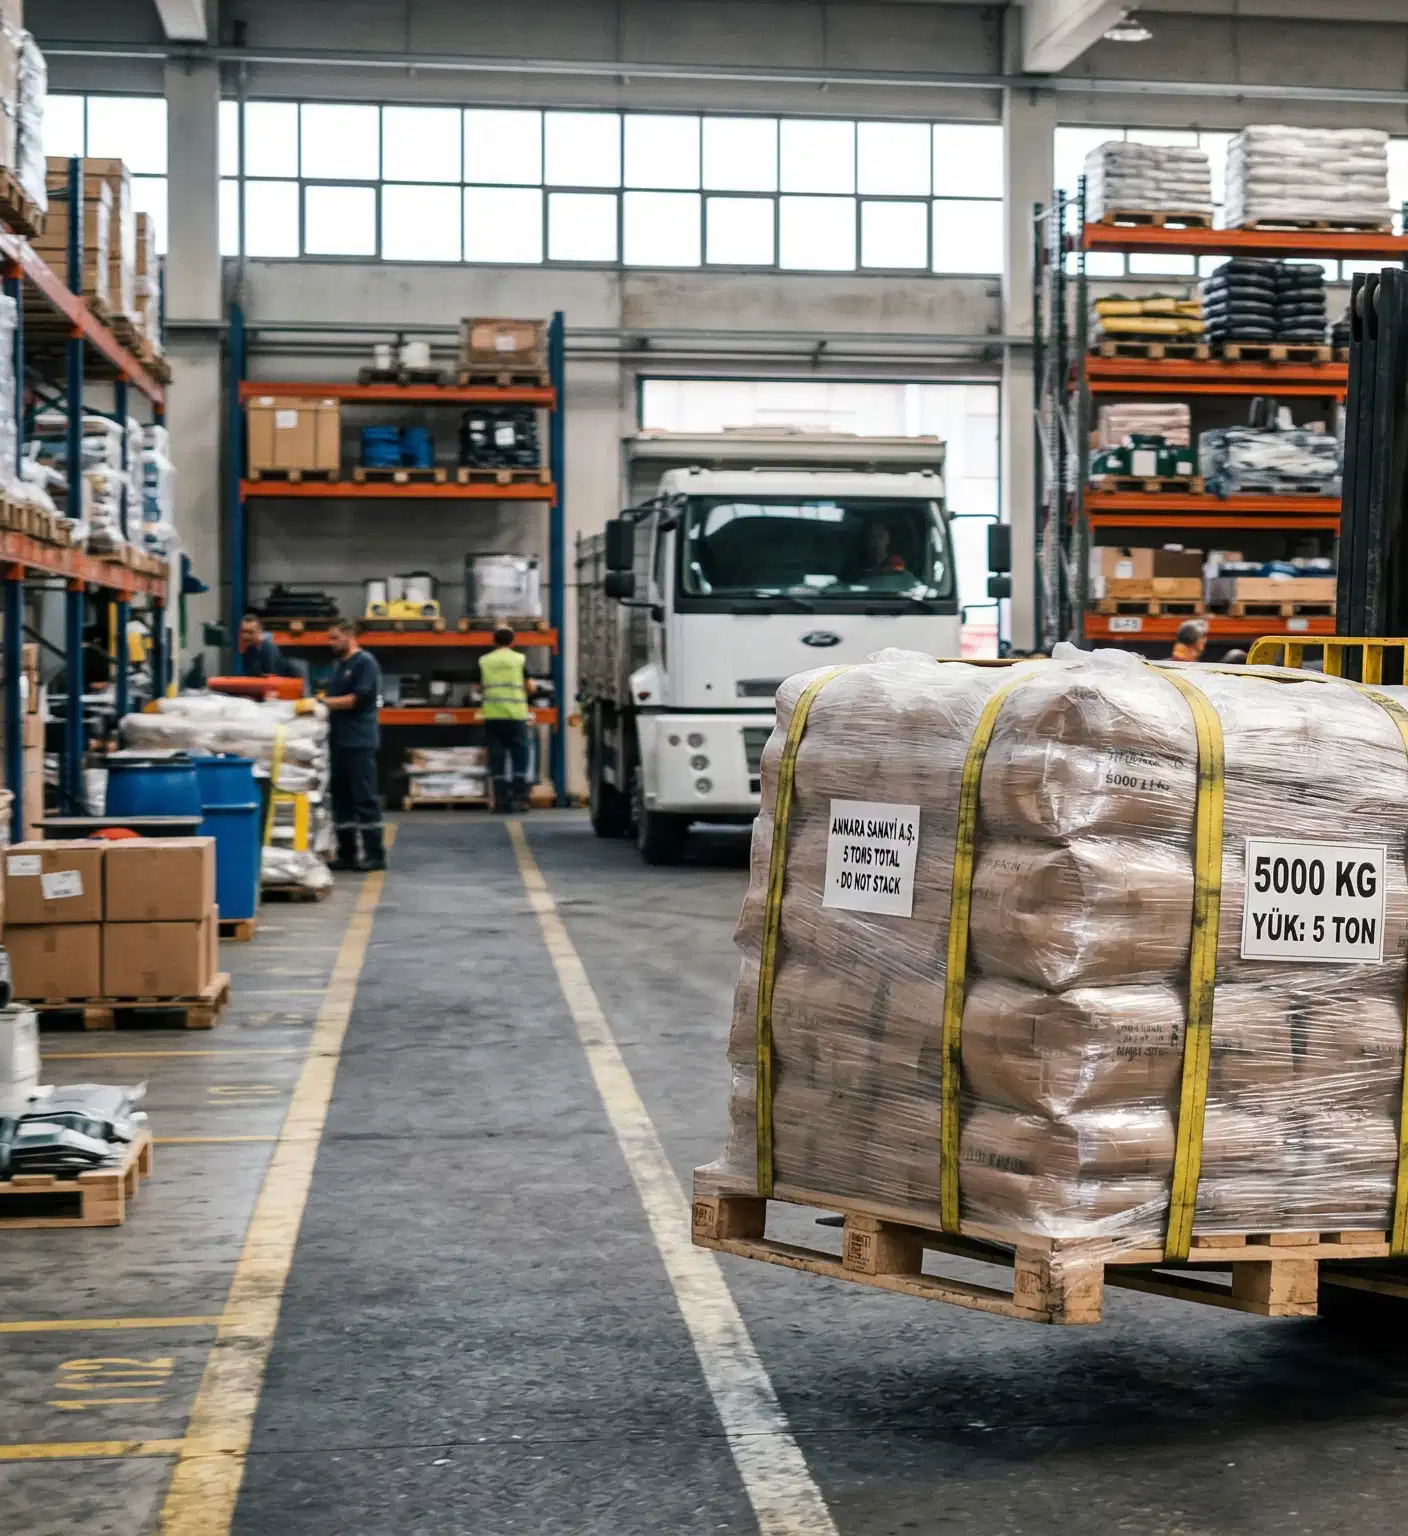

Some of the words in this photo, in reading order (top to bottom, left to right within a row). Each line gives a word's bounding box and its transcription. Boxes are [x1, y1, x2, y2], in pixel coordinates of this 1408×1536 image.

[843, 845, 849, 863] 5
[874, 848, 900, 868] TOTAL
[840, 871, 853, 890] DO
[854, 872, 872, 892] NOT
[873, 875, 902, 895] STACK
[1254, 856, 1326, 896] 5000
[1335, 861, 1377, 898] KG
[1252, 907, 1305, 942] YÜK:
[1312, 915, 1325, 943] 5
[1332, 916, 1376, 945] TON
